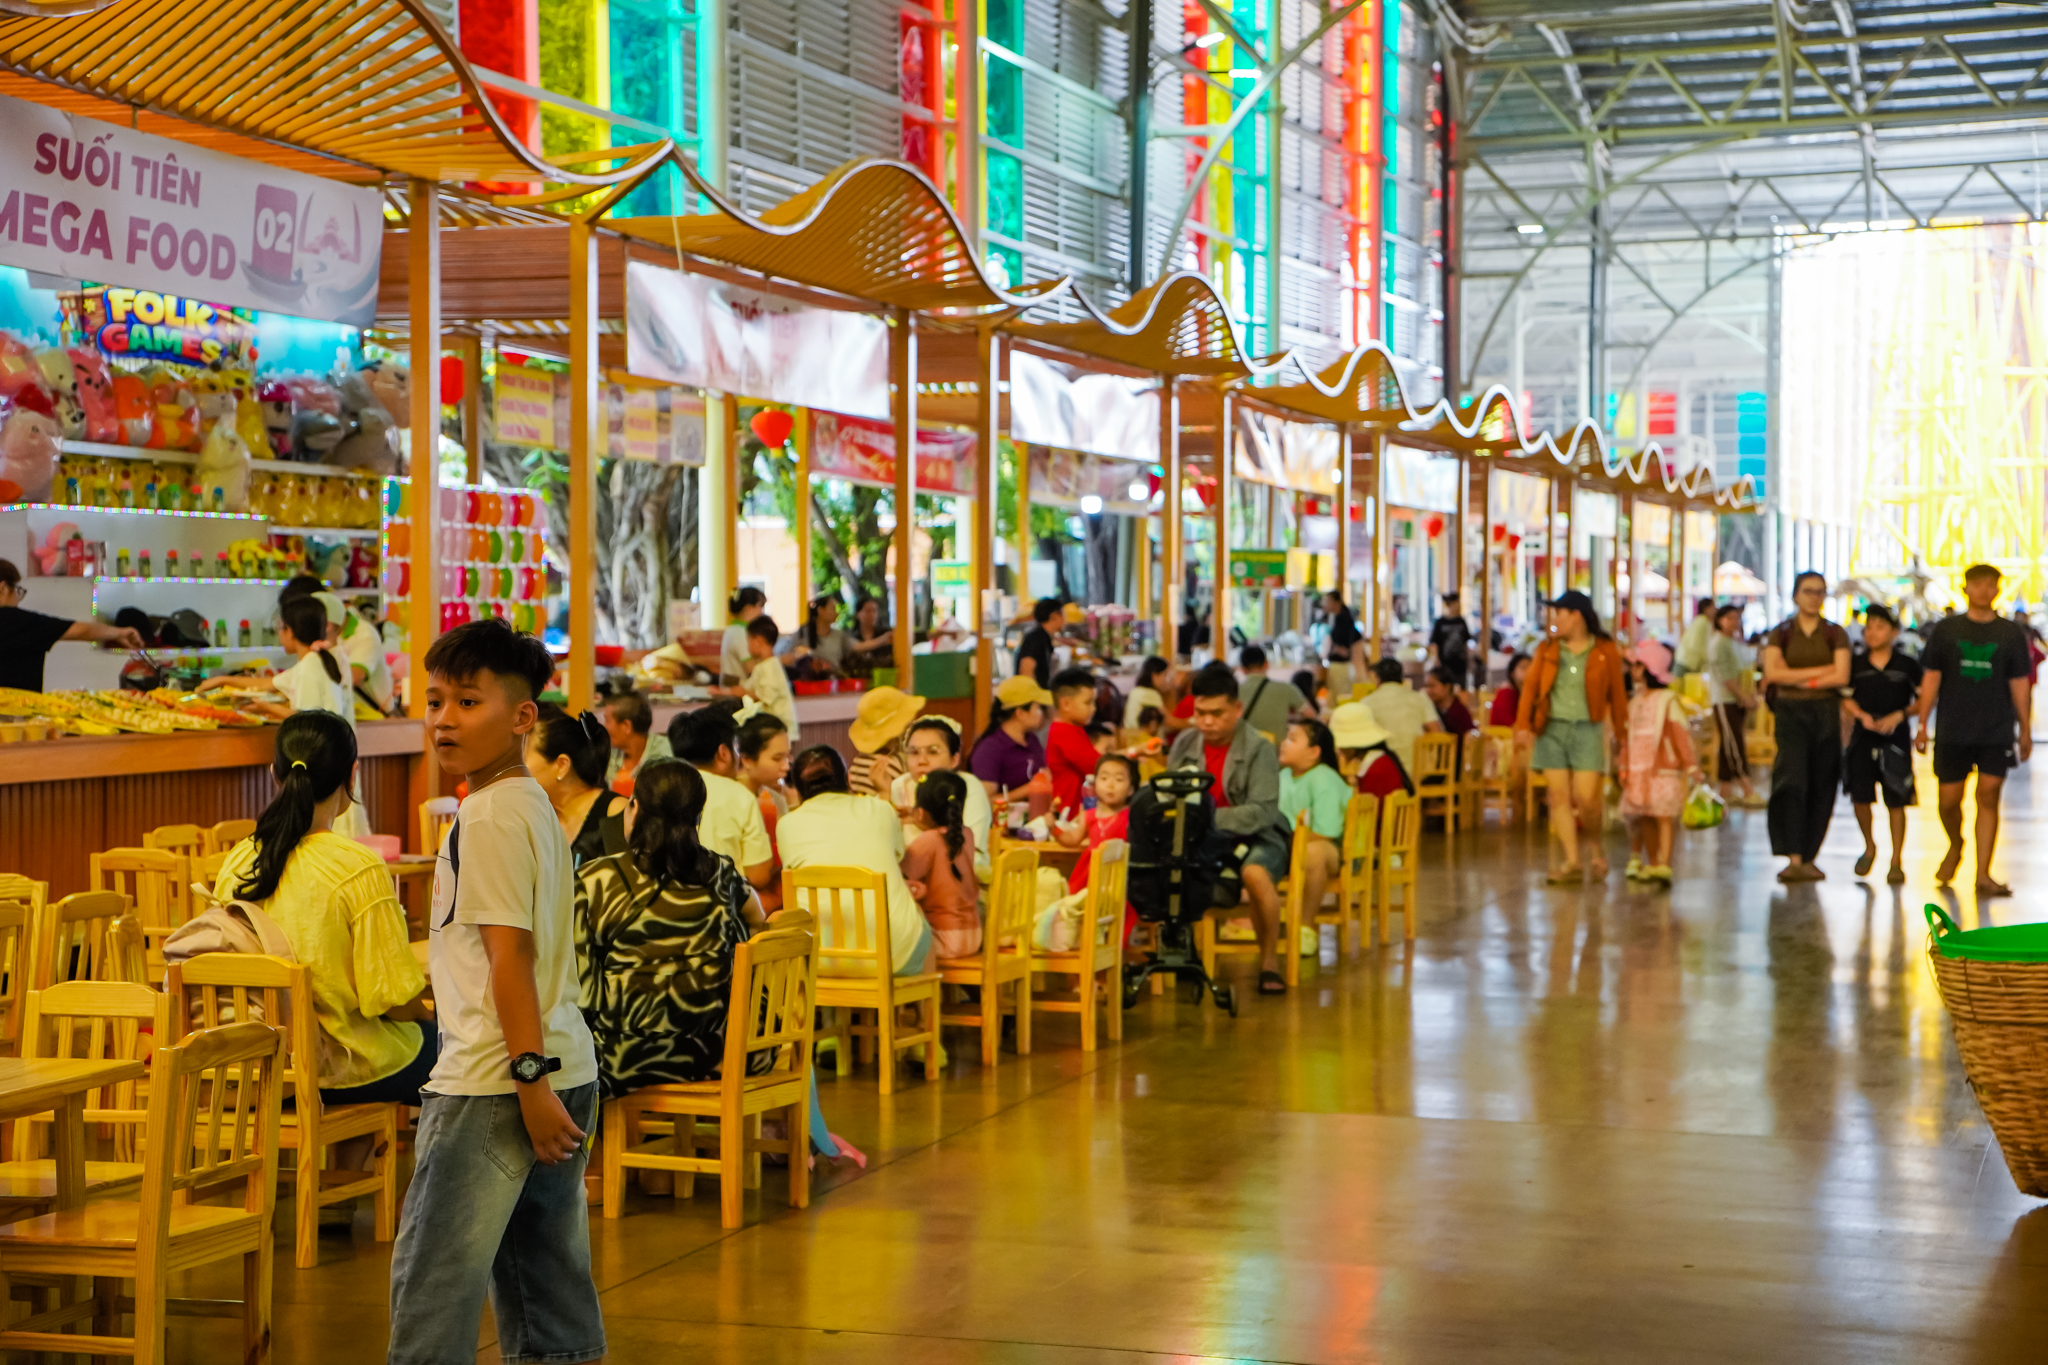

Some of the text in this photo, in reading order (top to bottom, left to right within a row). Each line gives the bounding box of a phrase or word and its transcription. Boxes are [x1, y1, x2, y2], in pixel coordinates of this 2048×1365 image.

[34, 132, 201, 208] SUỐI TIÊN
[126, 215, 236, 281] FOOD
[256, 207, 294, 253] 02
[107, 288, 215, 335] FOLK
[100, 322, 223, 365] GAMES
